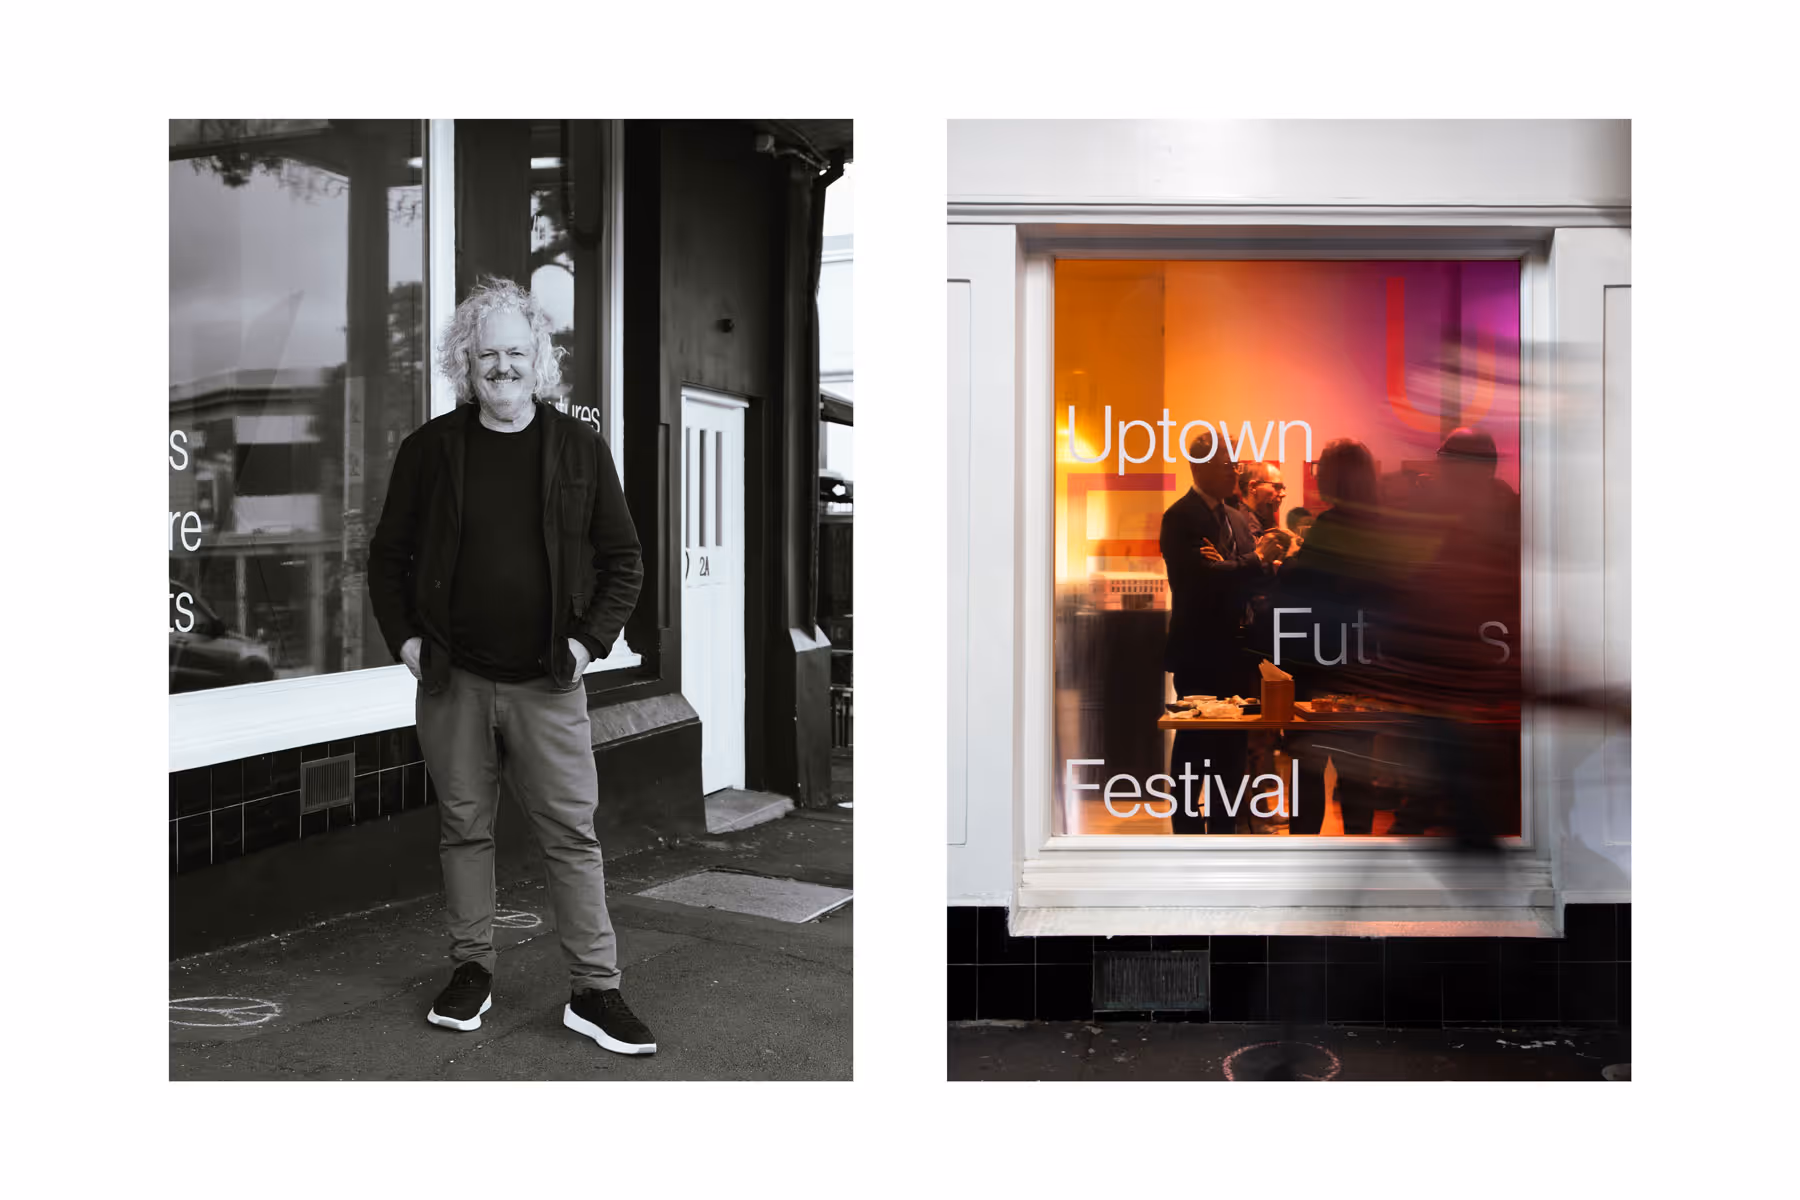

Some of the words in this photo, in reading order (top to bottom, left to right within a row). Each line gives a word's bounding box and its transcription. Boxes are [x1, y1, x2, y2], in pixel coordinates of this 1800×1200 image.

[1068, 405, 1313, 476] Uptown
[169, 511, 202, 551] re
[699, 556, 710, 577] 2A
[1273, 607, 1510, 665] Futs
[1065, 758, 1299, 818] Festival
